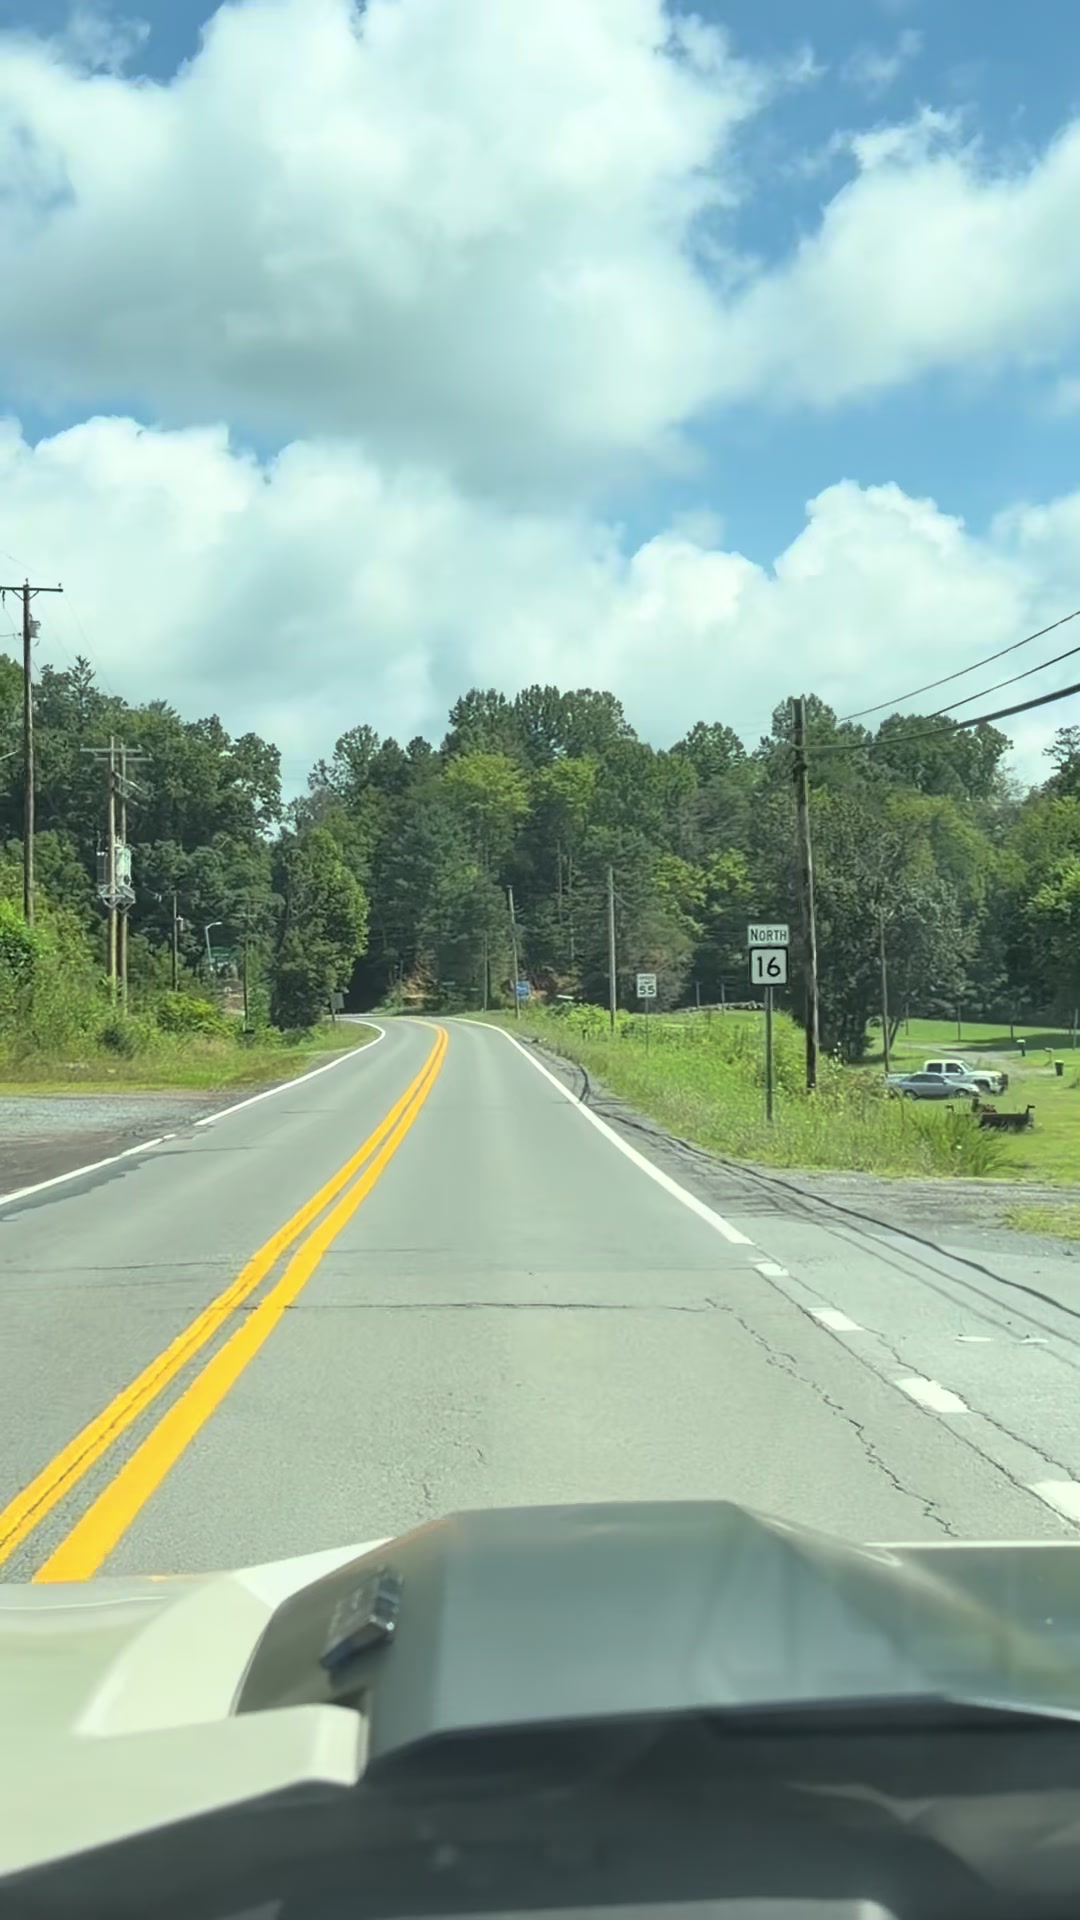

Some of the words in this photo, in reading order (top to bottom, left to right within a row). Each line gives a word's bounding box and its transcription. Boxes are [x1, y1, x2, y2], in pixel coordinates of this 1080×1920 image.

[750, 929, 787, 941] NORTH
[757, 956, 781, 977] 16
[639, 985, 655, 995] 55
